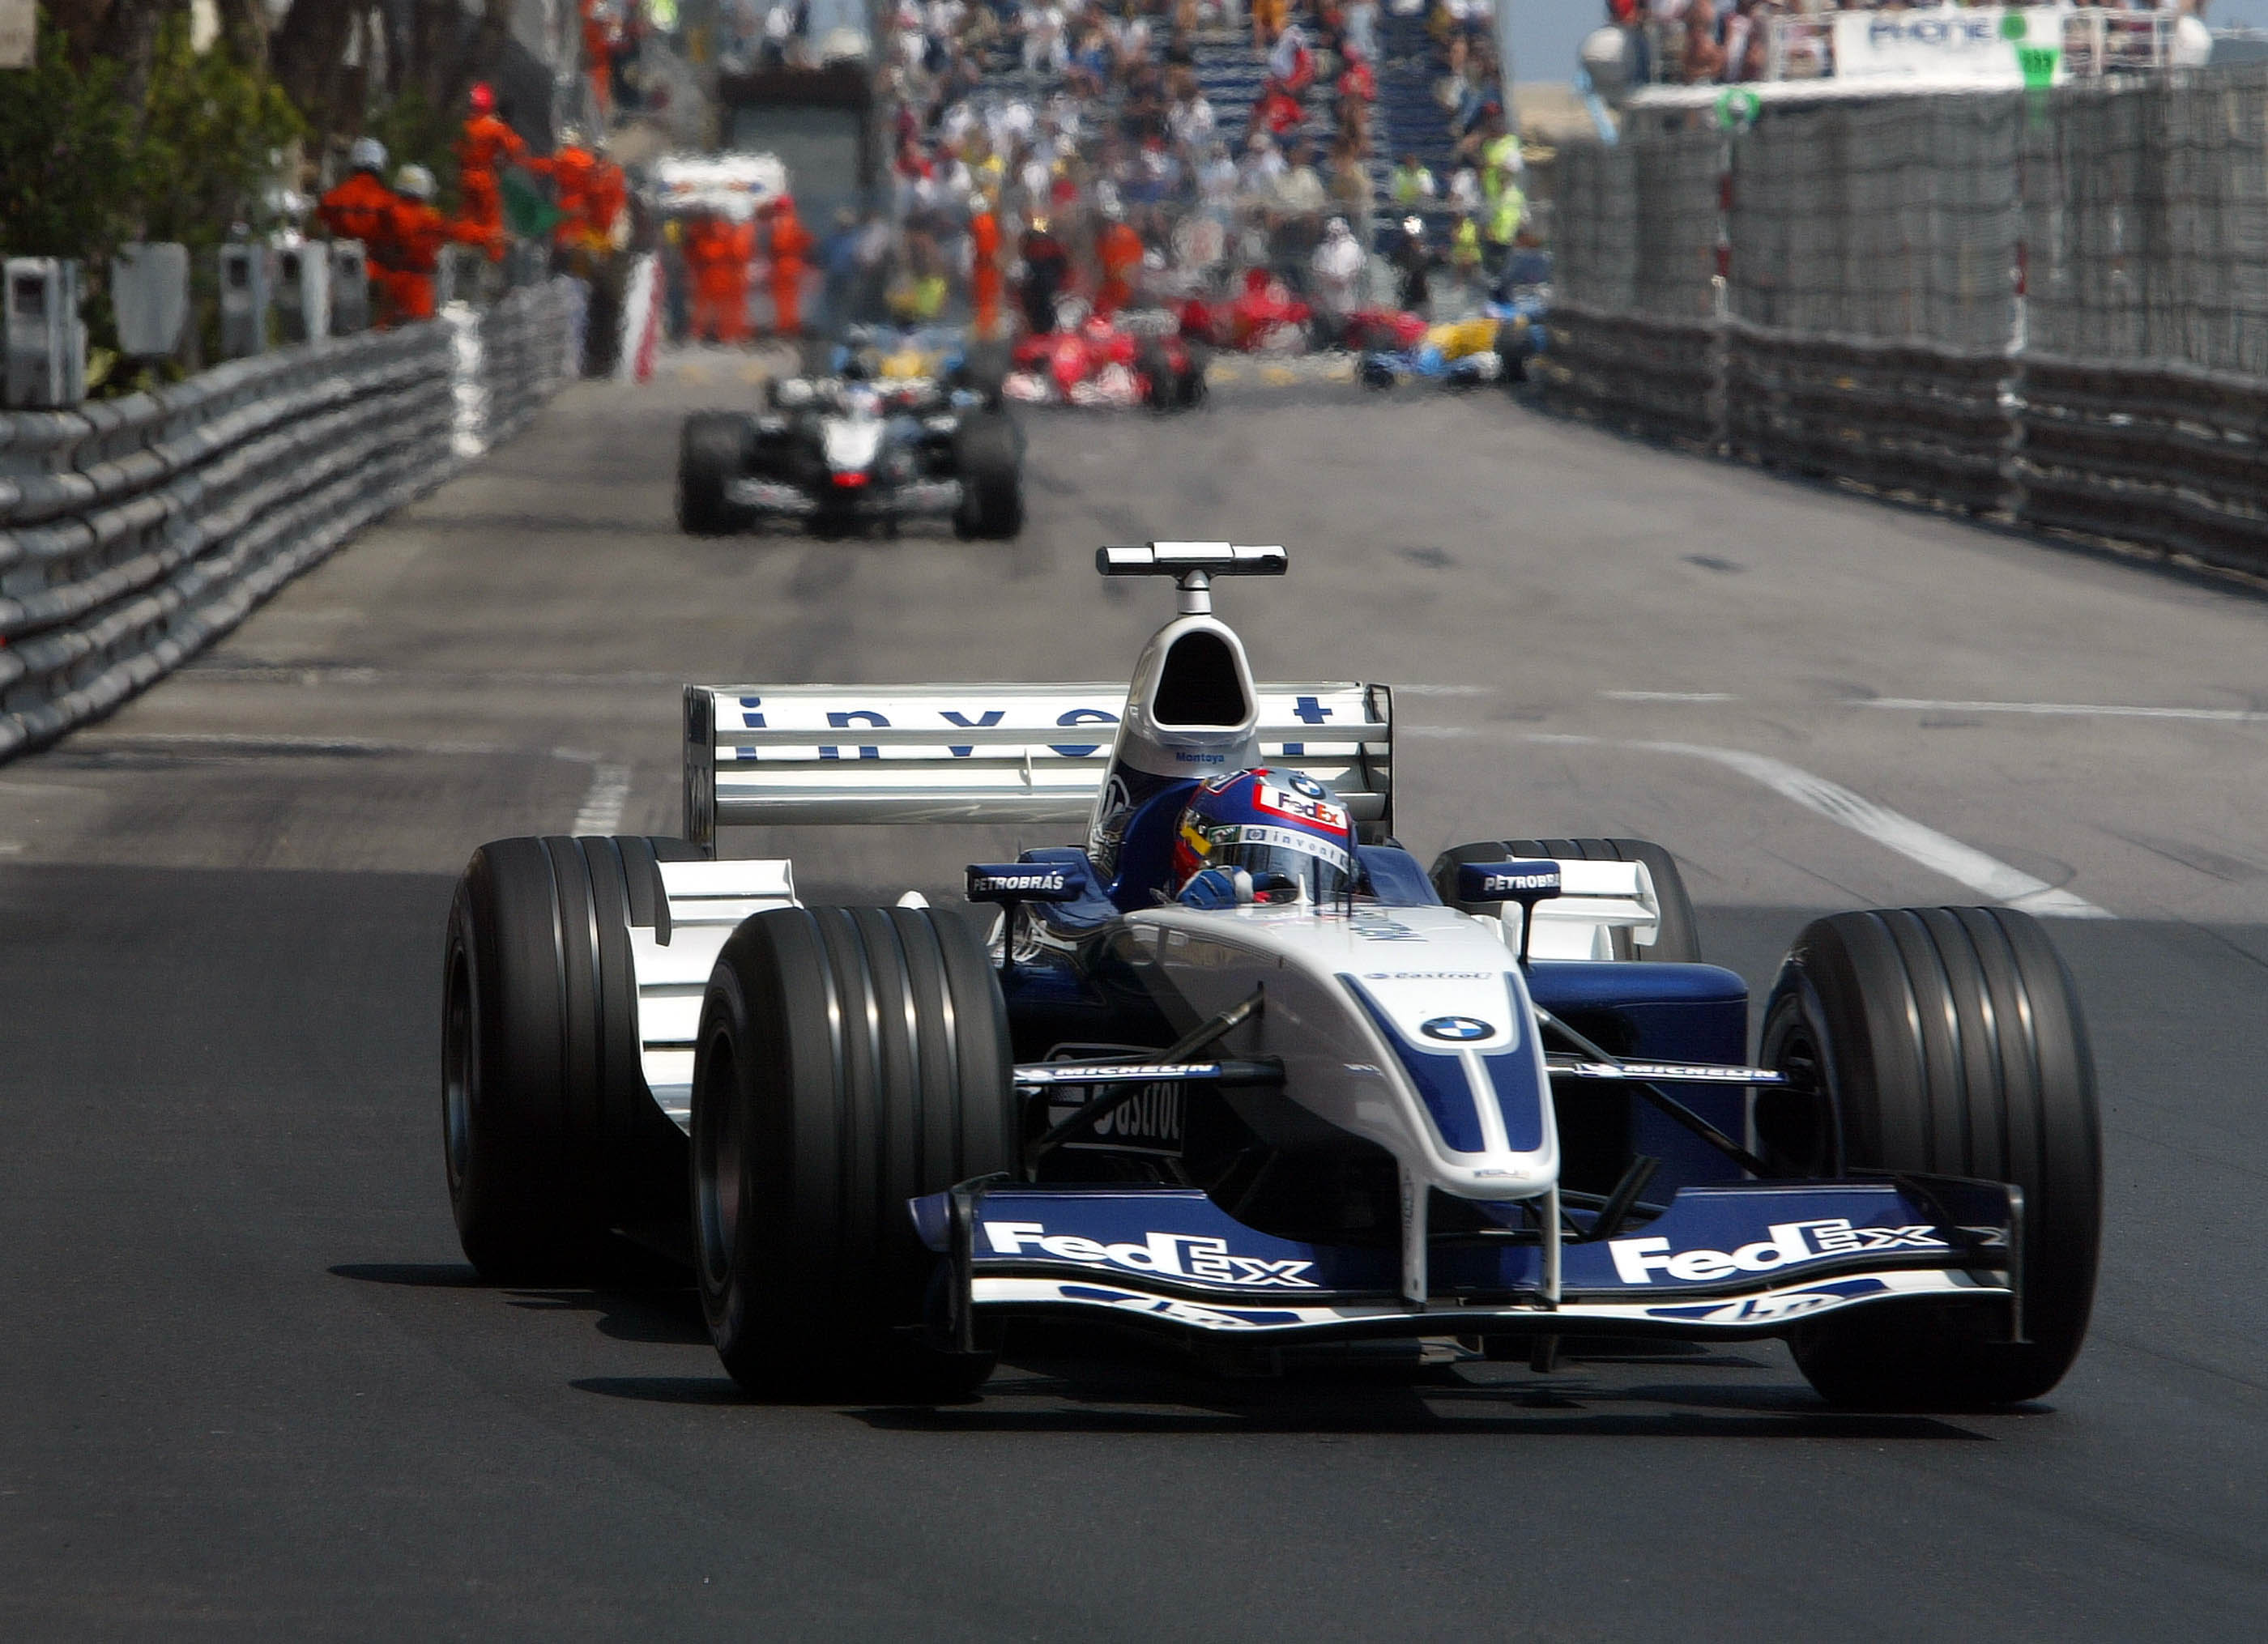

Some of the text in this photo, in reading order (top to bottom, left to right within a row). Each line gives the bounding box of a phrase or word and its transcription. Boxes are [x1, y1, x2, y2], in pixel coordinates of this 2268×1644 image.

[735, 696, 1333, 760] invet
[1176, 752, 1225, 765] Montoya
[1278, 791, 1339, 825] FedEx
[974, 875, 1064, 891] PETROBRAS
[1055, 1064, 1213, 1076] MICHELIN
[1622, 1065, 1779, 1077] MICHELIN
[983, 1221, 1320, 1287] FedEx
[1608, 1218, 1949, 1284] FedEx
